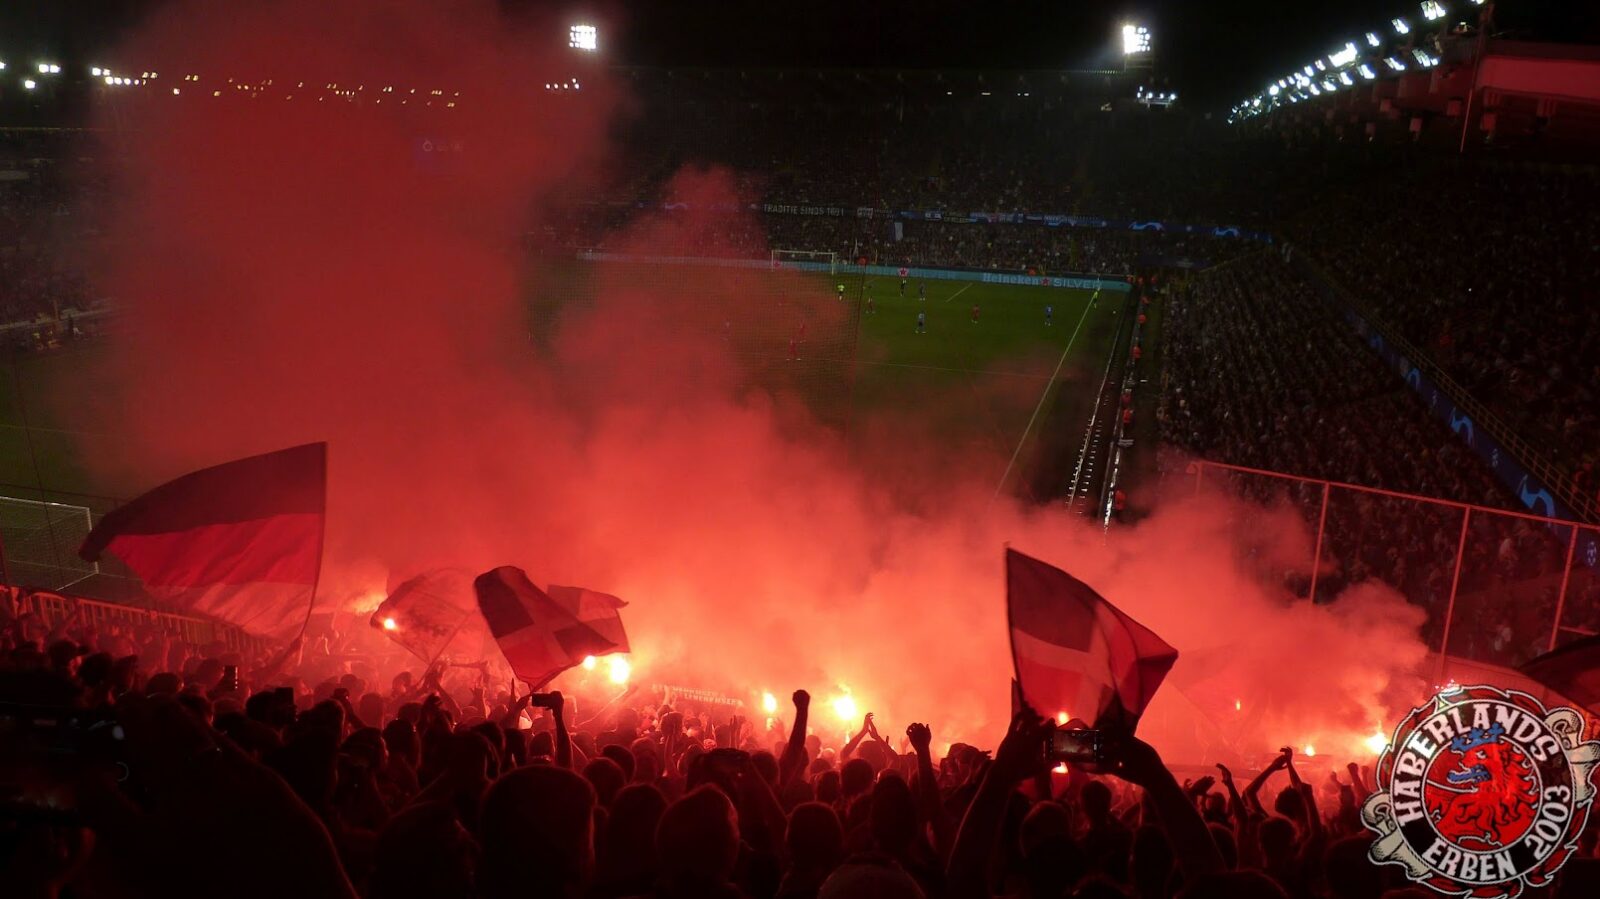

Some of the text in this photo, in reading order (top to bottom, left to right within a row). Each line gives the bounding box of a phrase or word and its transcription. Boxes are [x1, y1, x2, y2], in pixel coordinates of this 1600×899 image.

[763, 204, 799, 216] TRADITIE
[800, 206, 824, 217] SINDS
[982, 272, 1103, 289] Heineken SILVER
